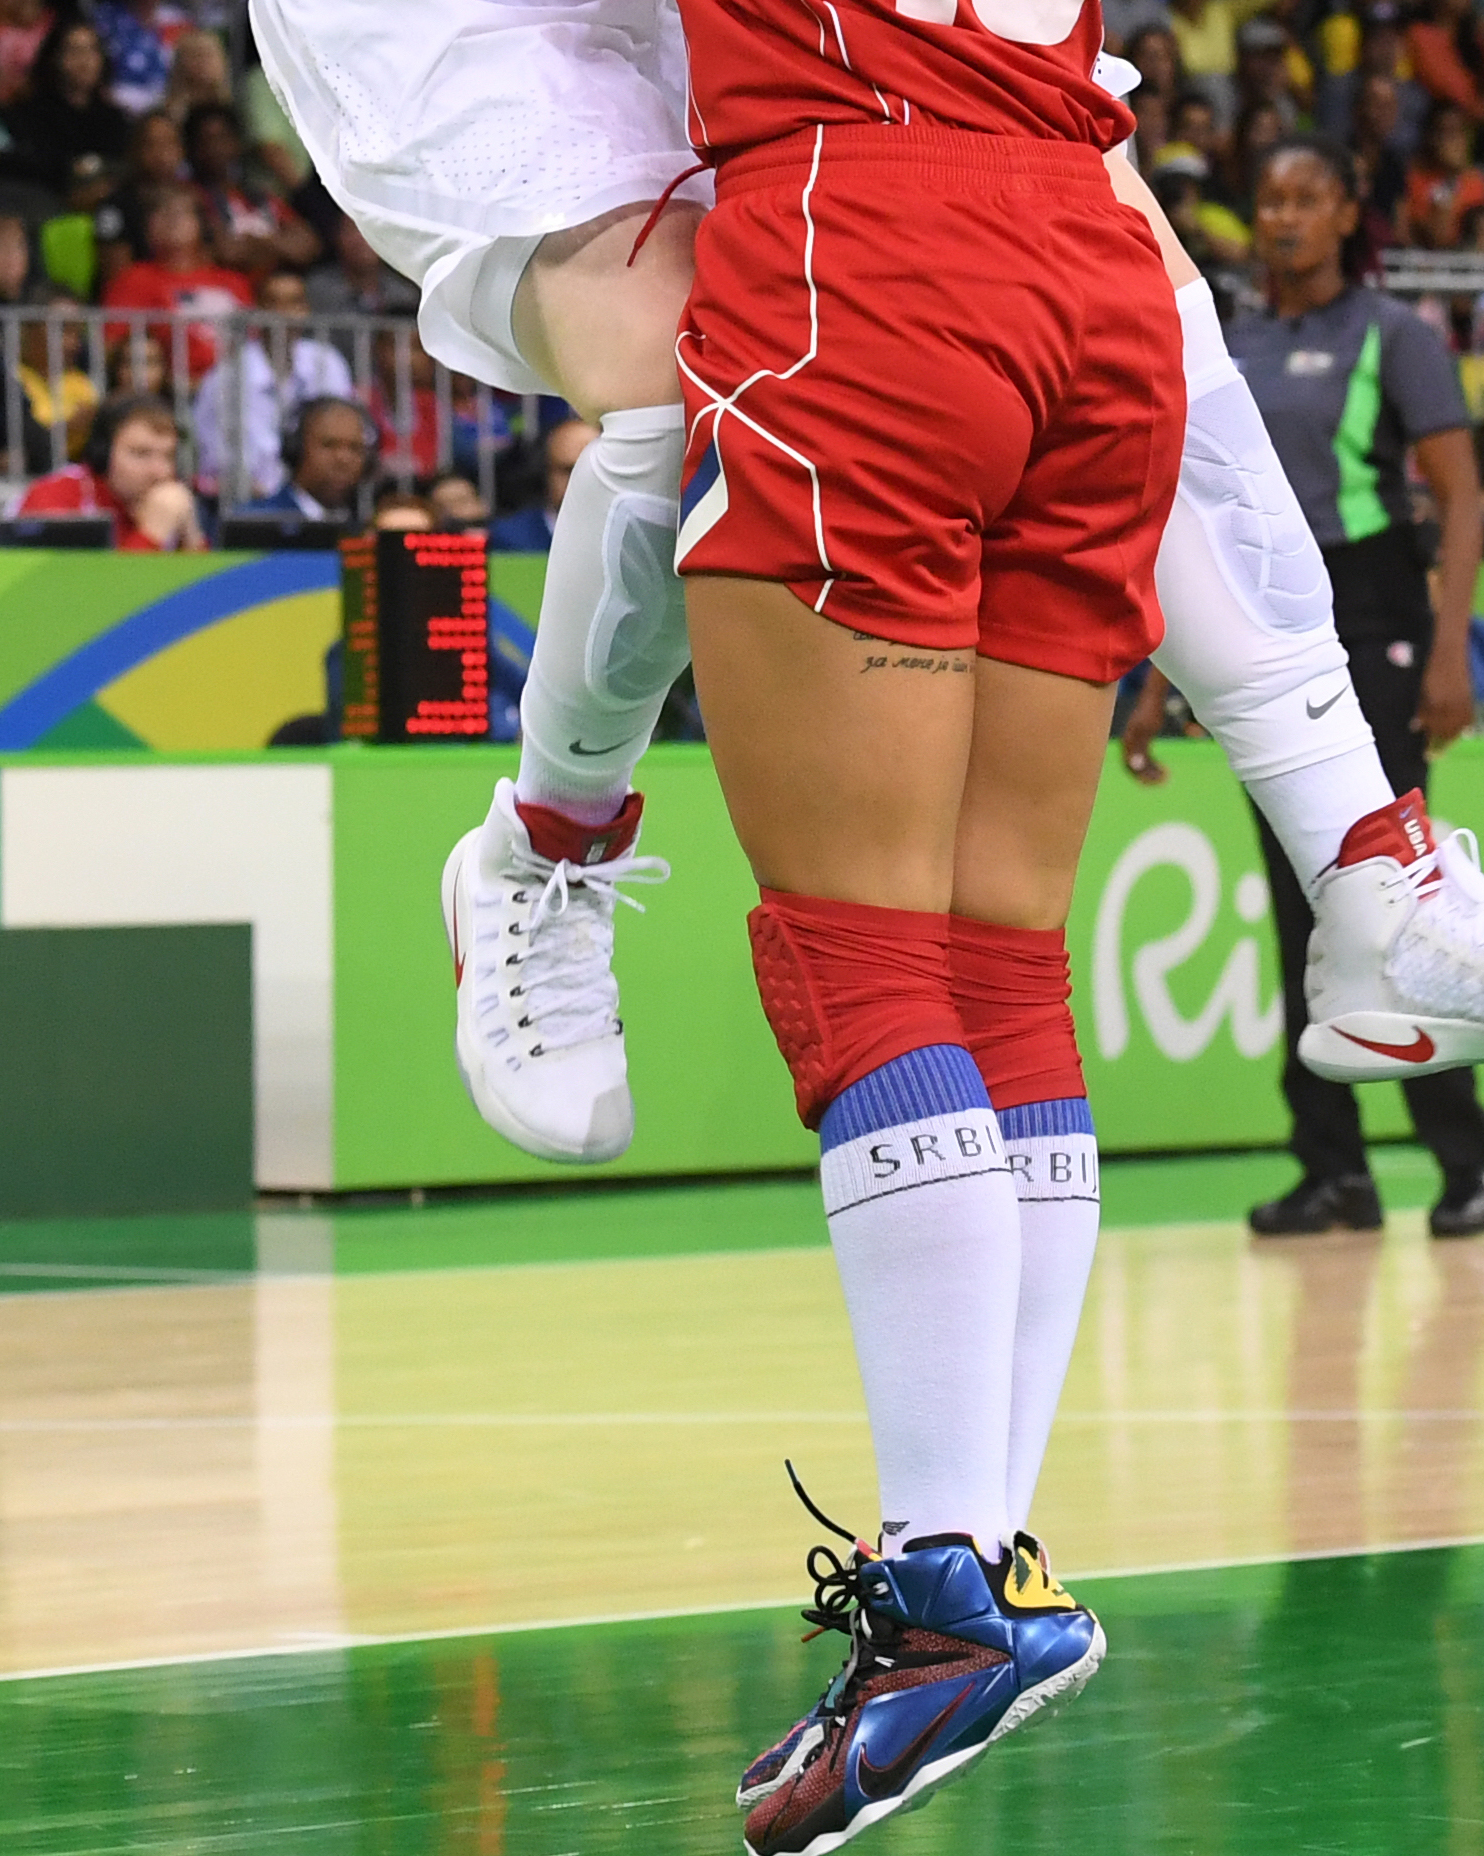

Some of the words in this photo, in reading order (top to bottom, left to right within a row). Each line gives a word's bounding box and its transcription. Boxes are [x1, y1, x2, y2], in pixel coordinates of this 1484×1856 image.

[403, 532, 489, 735] 3
[1403, 818, 1428, 858] USA
[1090, 819, 1285, 1062] Ri
